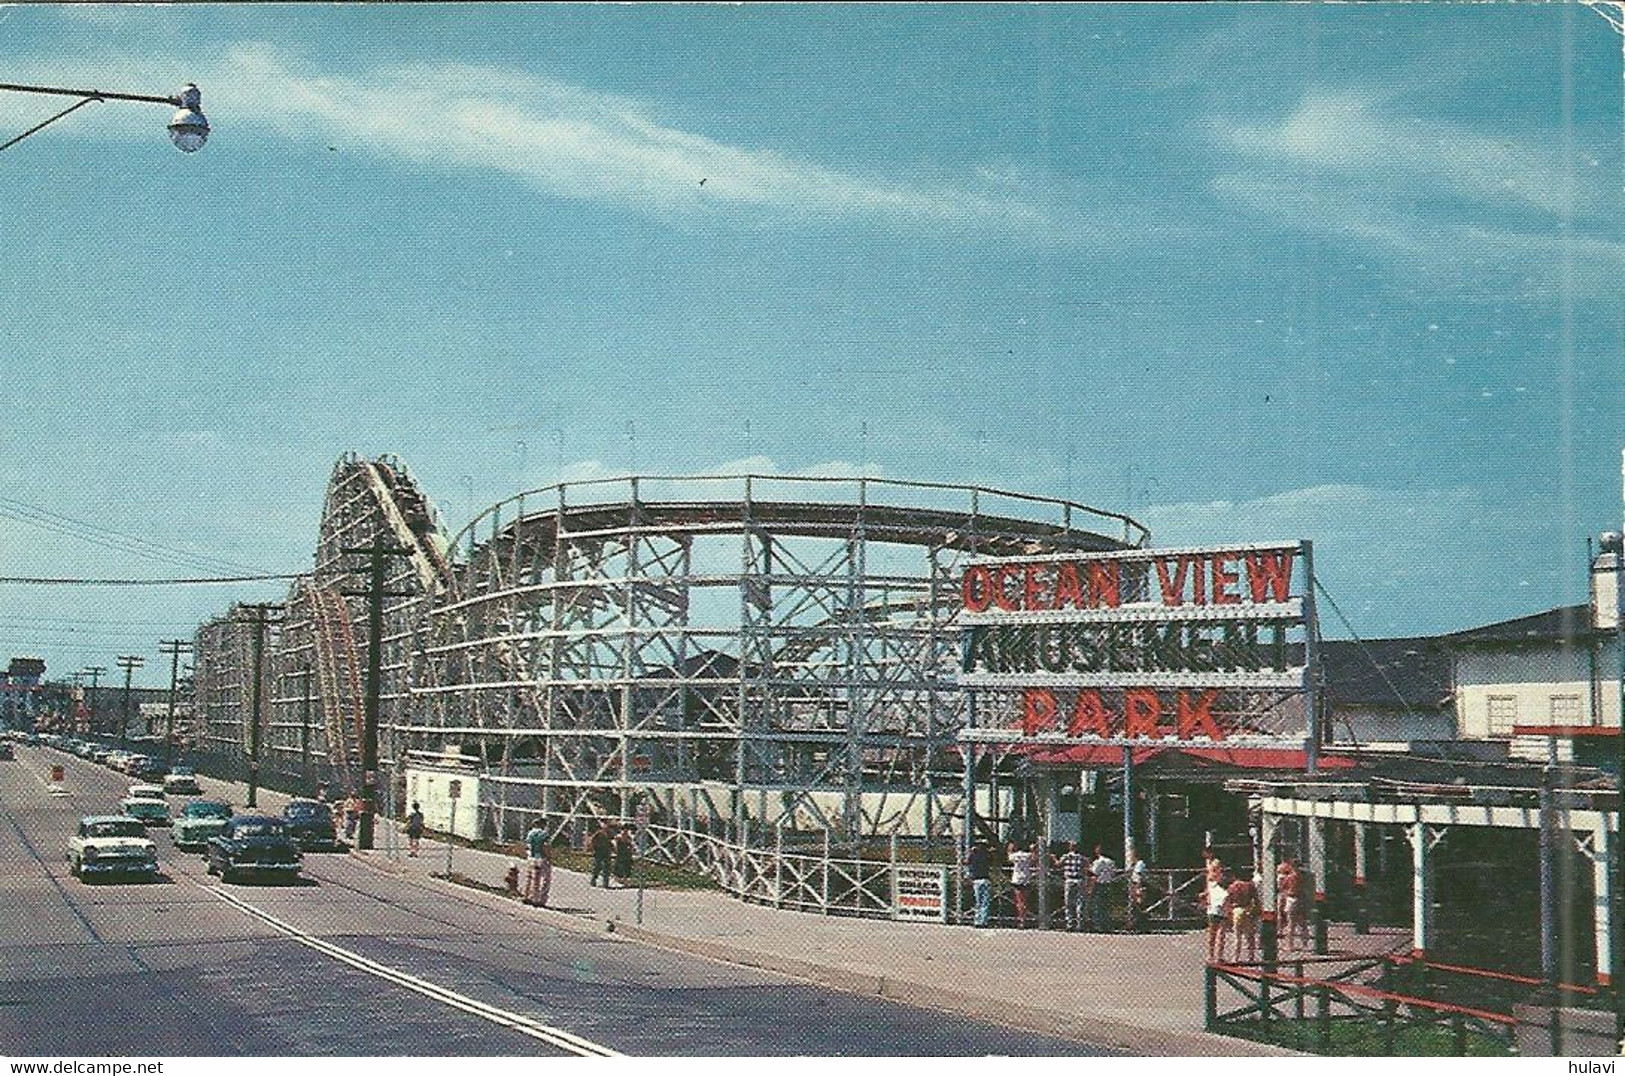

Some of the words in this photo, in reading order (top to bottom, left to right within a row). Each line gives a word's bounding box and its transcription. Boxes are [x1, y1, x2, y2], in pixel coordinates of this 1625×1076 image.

[962, 561, 1120, 612] OCEAN
[1154, 551, 1294, 607] VIEW
[1023, 688, 1223, 741] PARK
